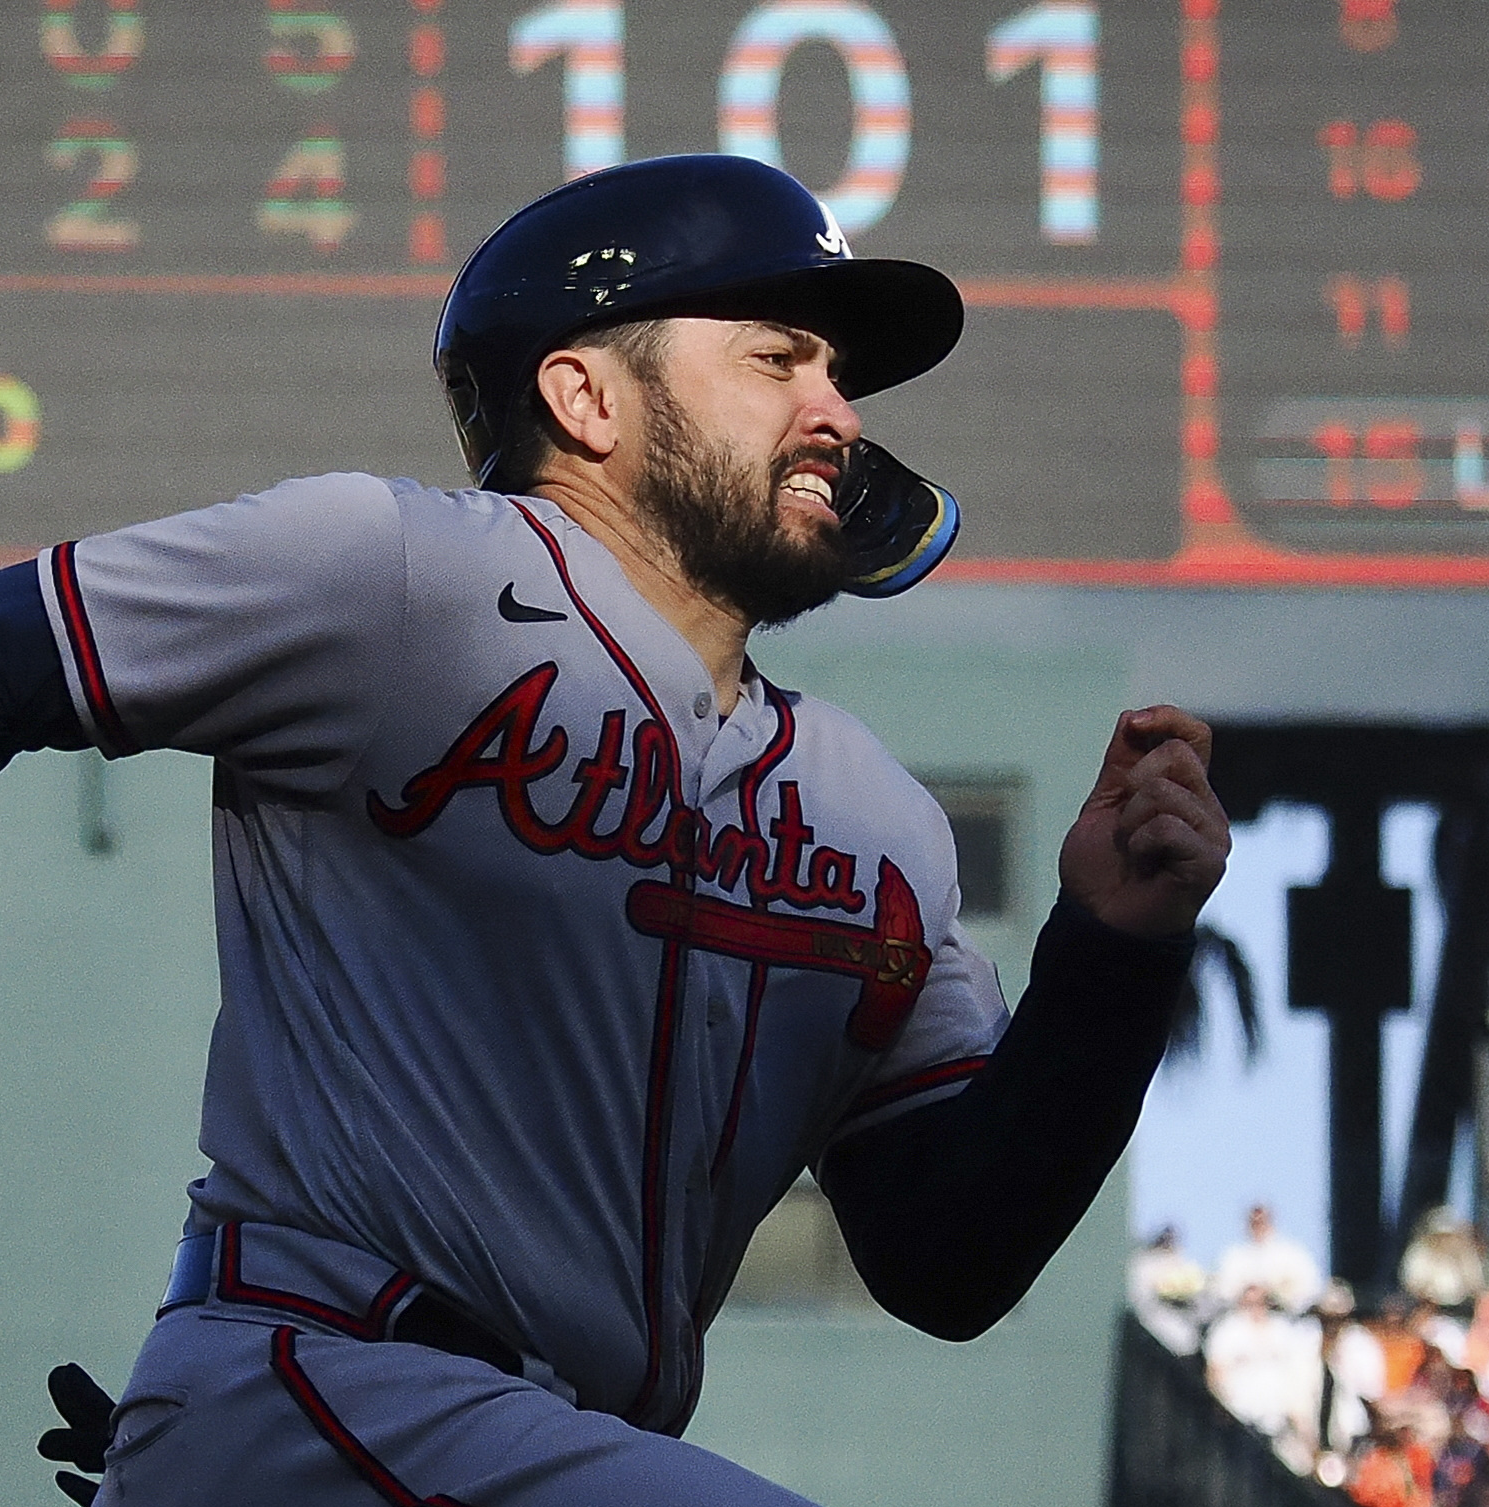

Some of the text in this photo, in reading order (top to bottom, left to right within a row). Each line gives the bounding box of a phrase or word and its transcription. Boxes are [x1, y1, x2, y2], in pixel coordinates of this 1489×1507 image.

[46, 115, 141, 252] 2
[258, 123, 358, 253] 4
[1323, 272, 1410, 350] 11
[1313, 418, 1423, 509] 15
[366, 660, 867, 914] Atlanta
